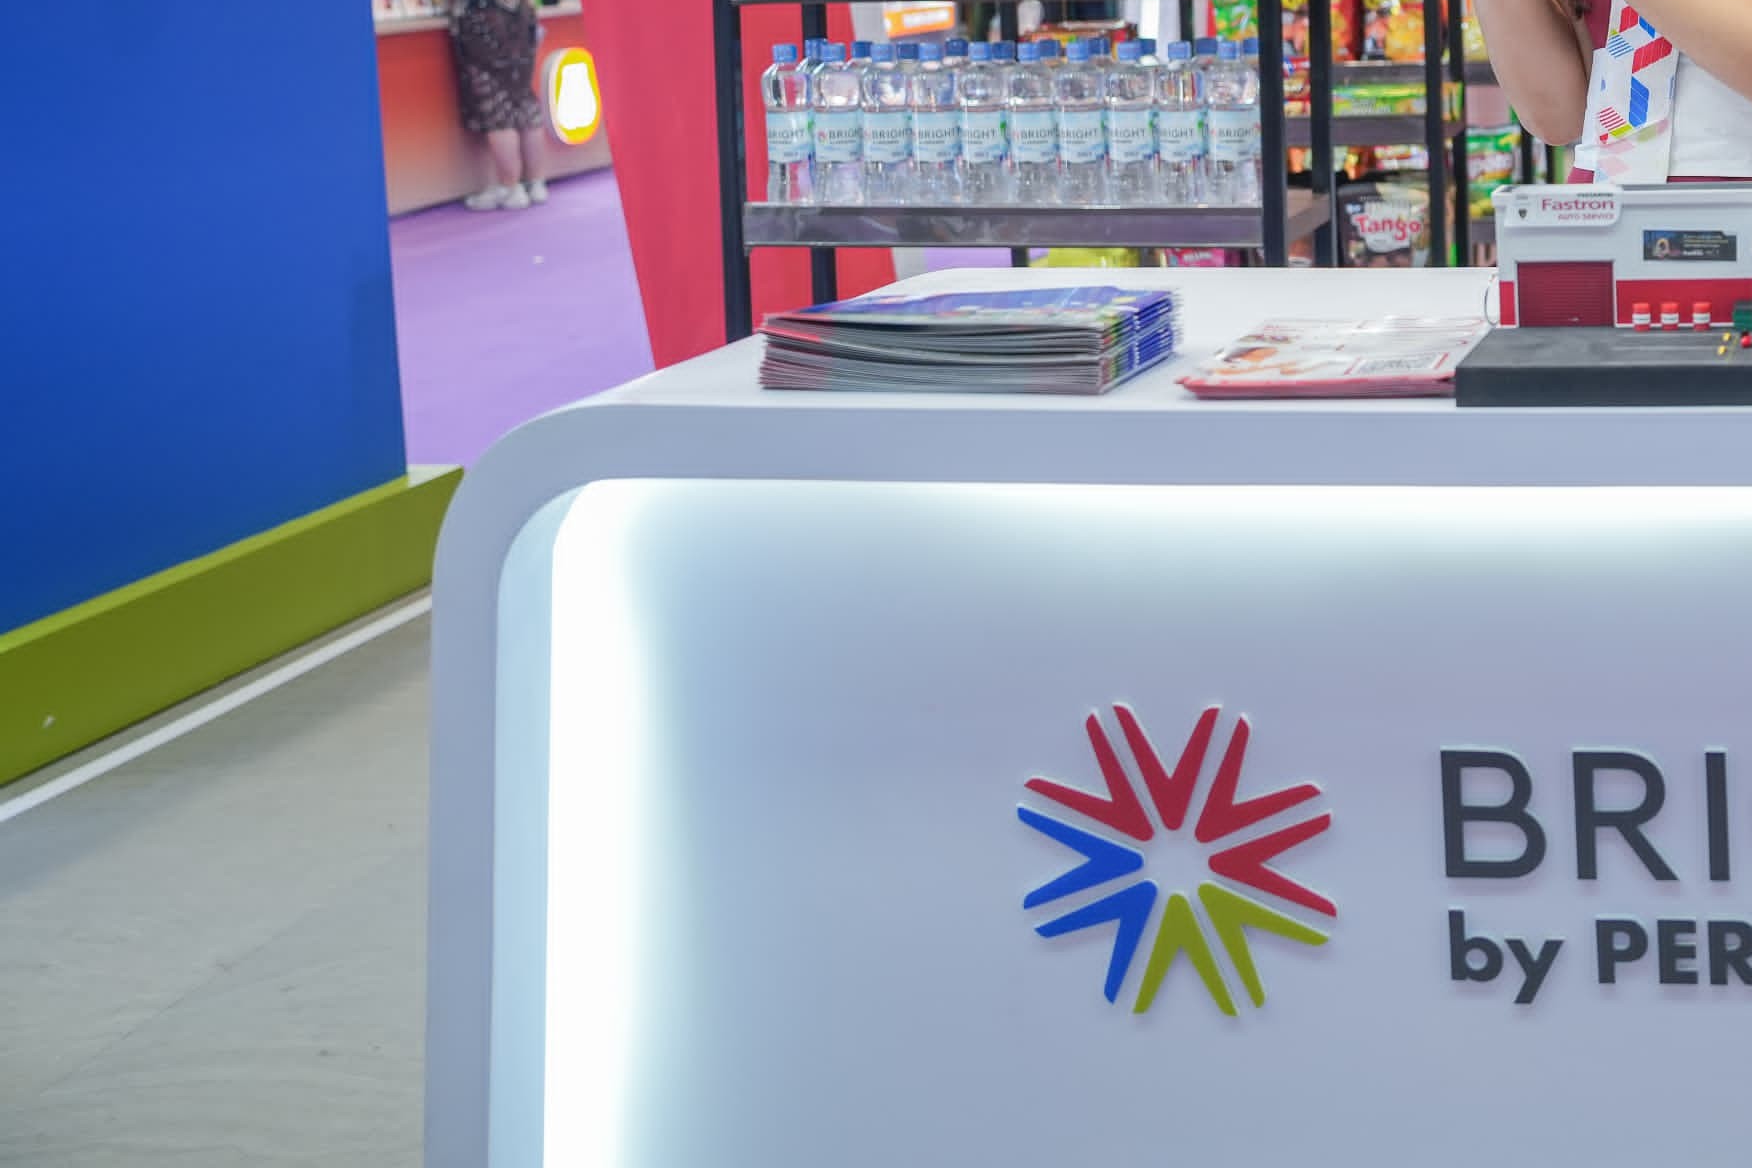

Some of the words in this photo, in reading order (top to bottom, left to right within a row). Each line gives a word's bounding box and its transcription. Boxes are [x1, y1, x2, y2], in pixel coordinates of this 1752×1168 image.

[1541, 198, 1615, 211] Fastron
[1355, 215, 1421, 241] Tango
[1447, 908, 1565, 1005] by
